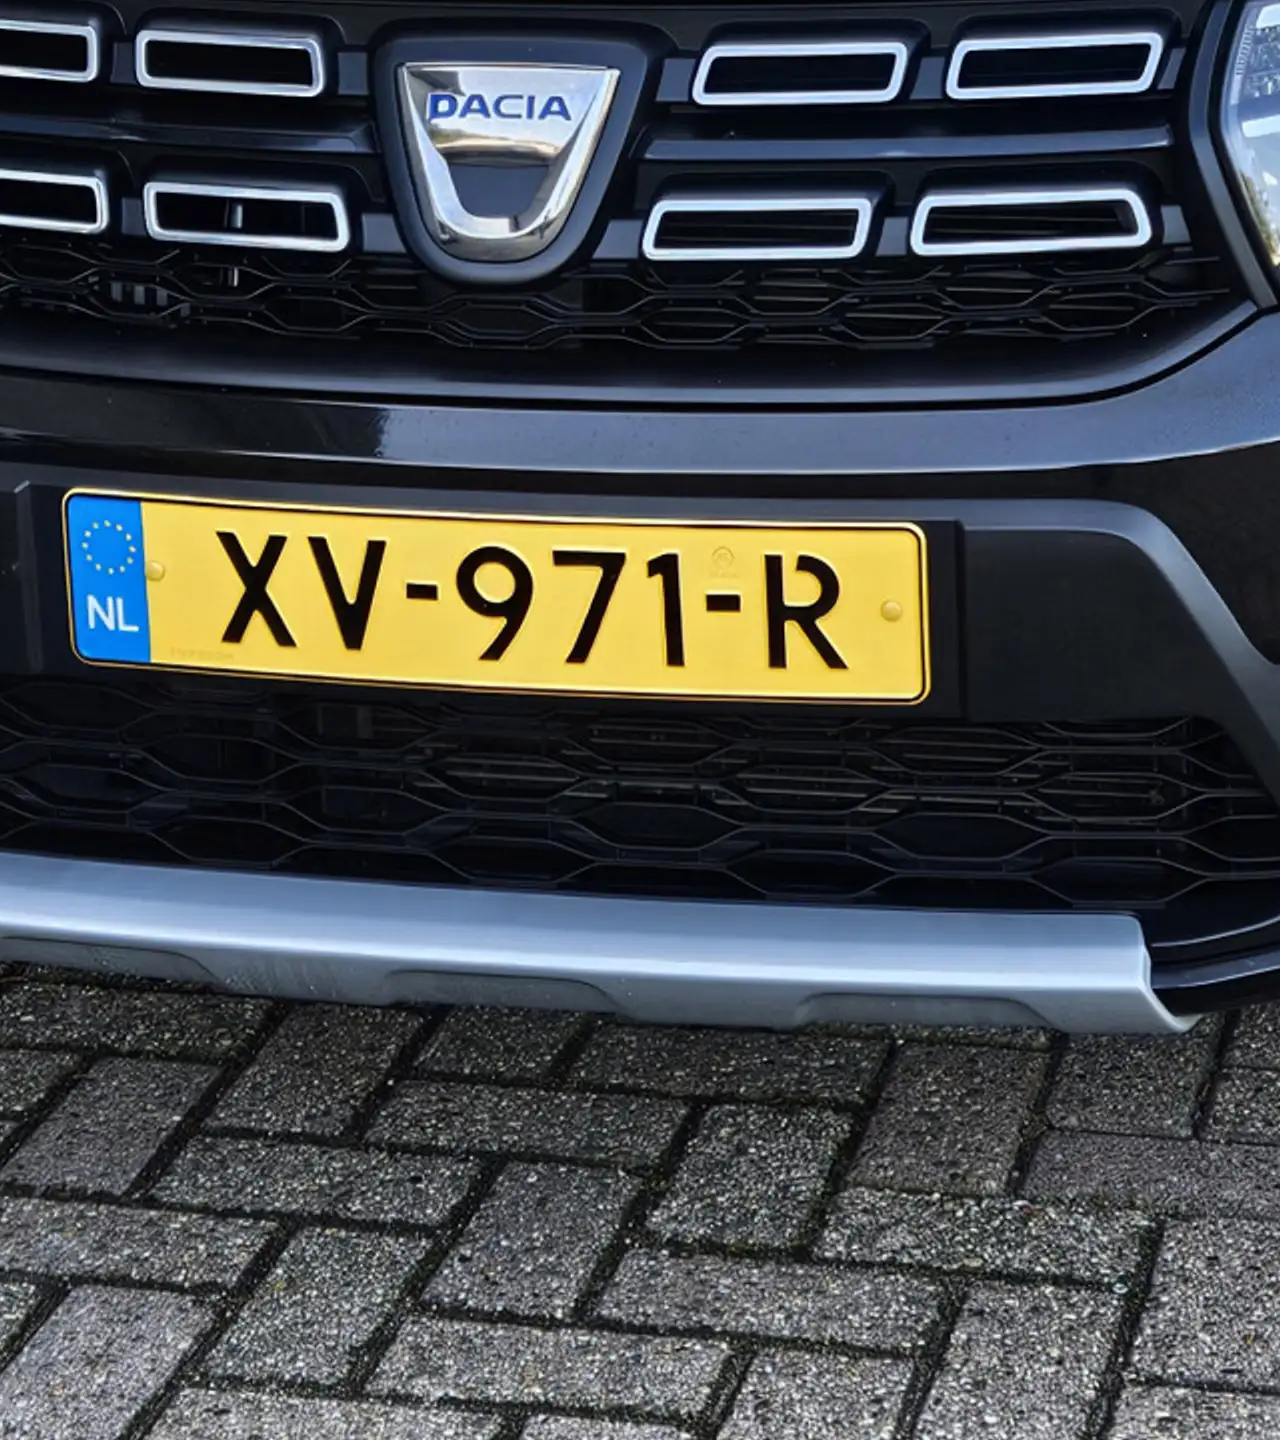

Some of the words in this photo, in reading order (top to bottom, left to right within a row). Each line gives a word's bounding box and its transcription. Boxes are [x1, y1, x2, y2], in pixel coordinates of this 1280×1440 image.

[428, 93, 572, 122] DACIA
[86, 593, 139, 633] NL
[216, 530, 850, 670] XV-971-R
